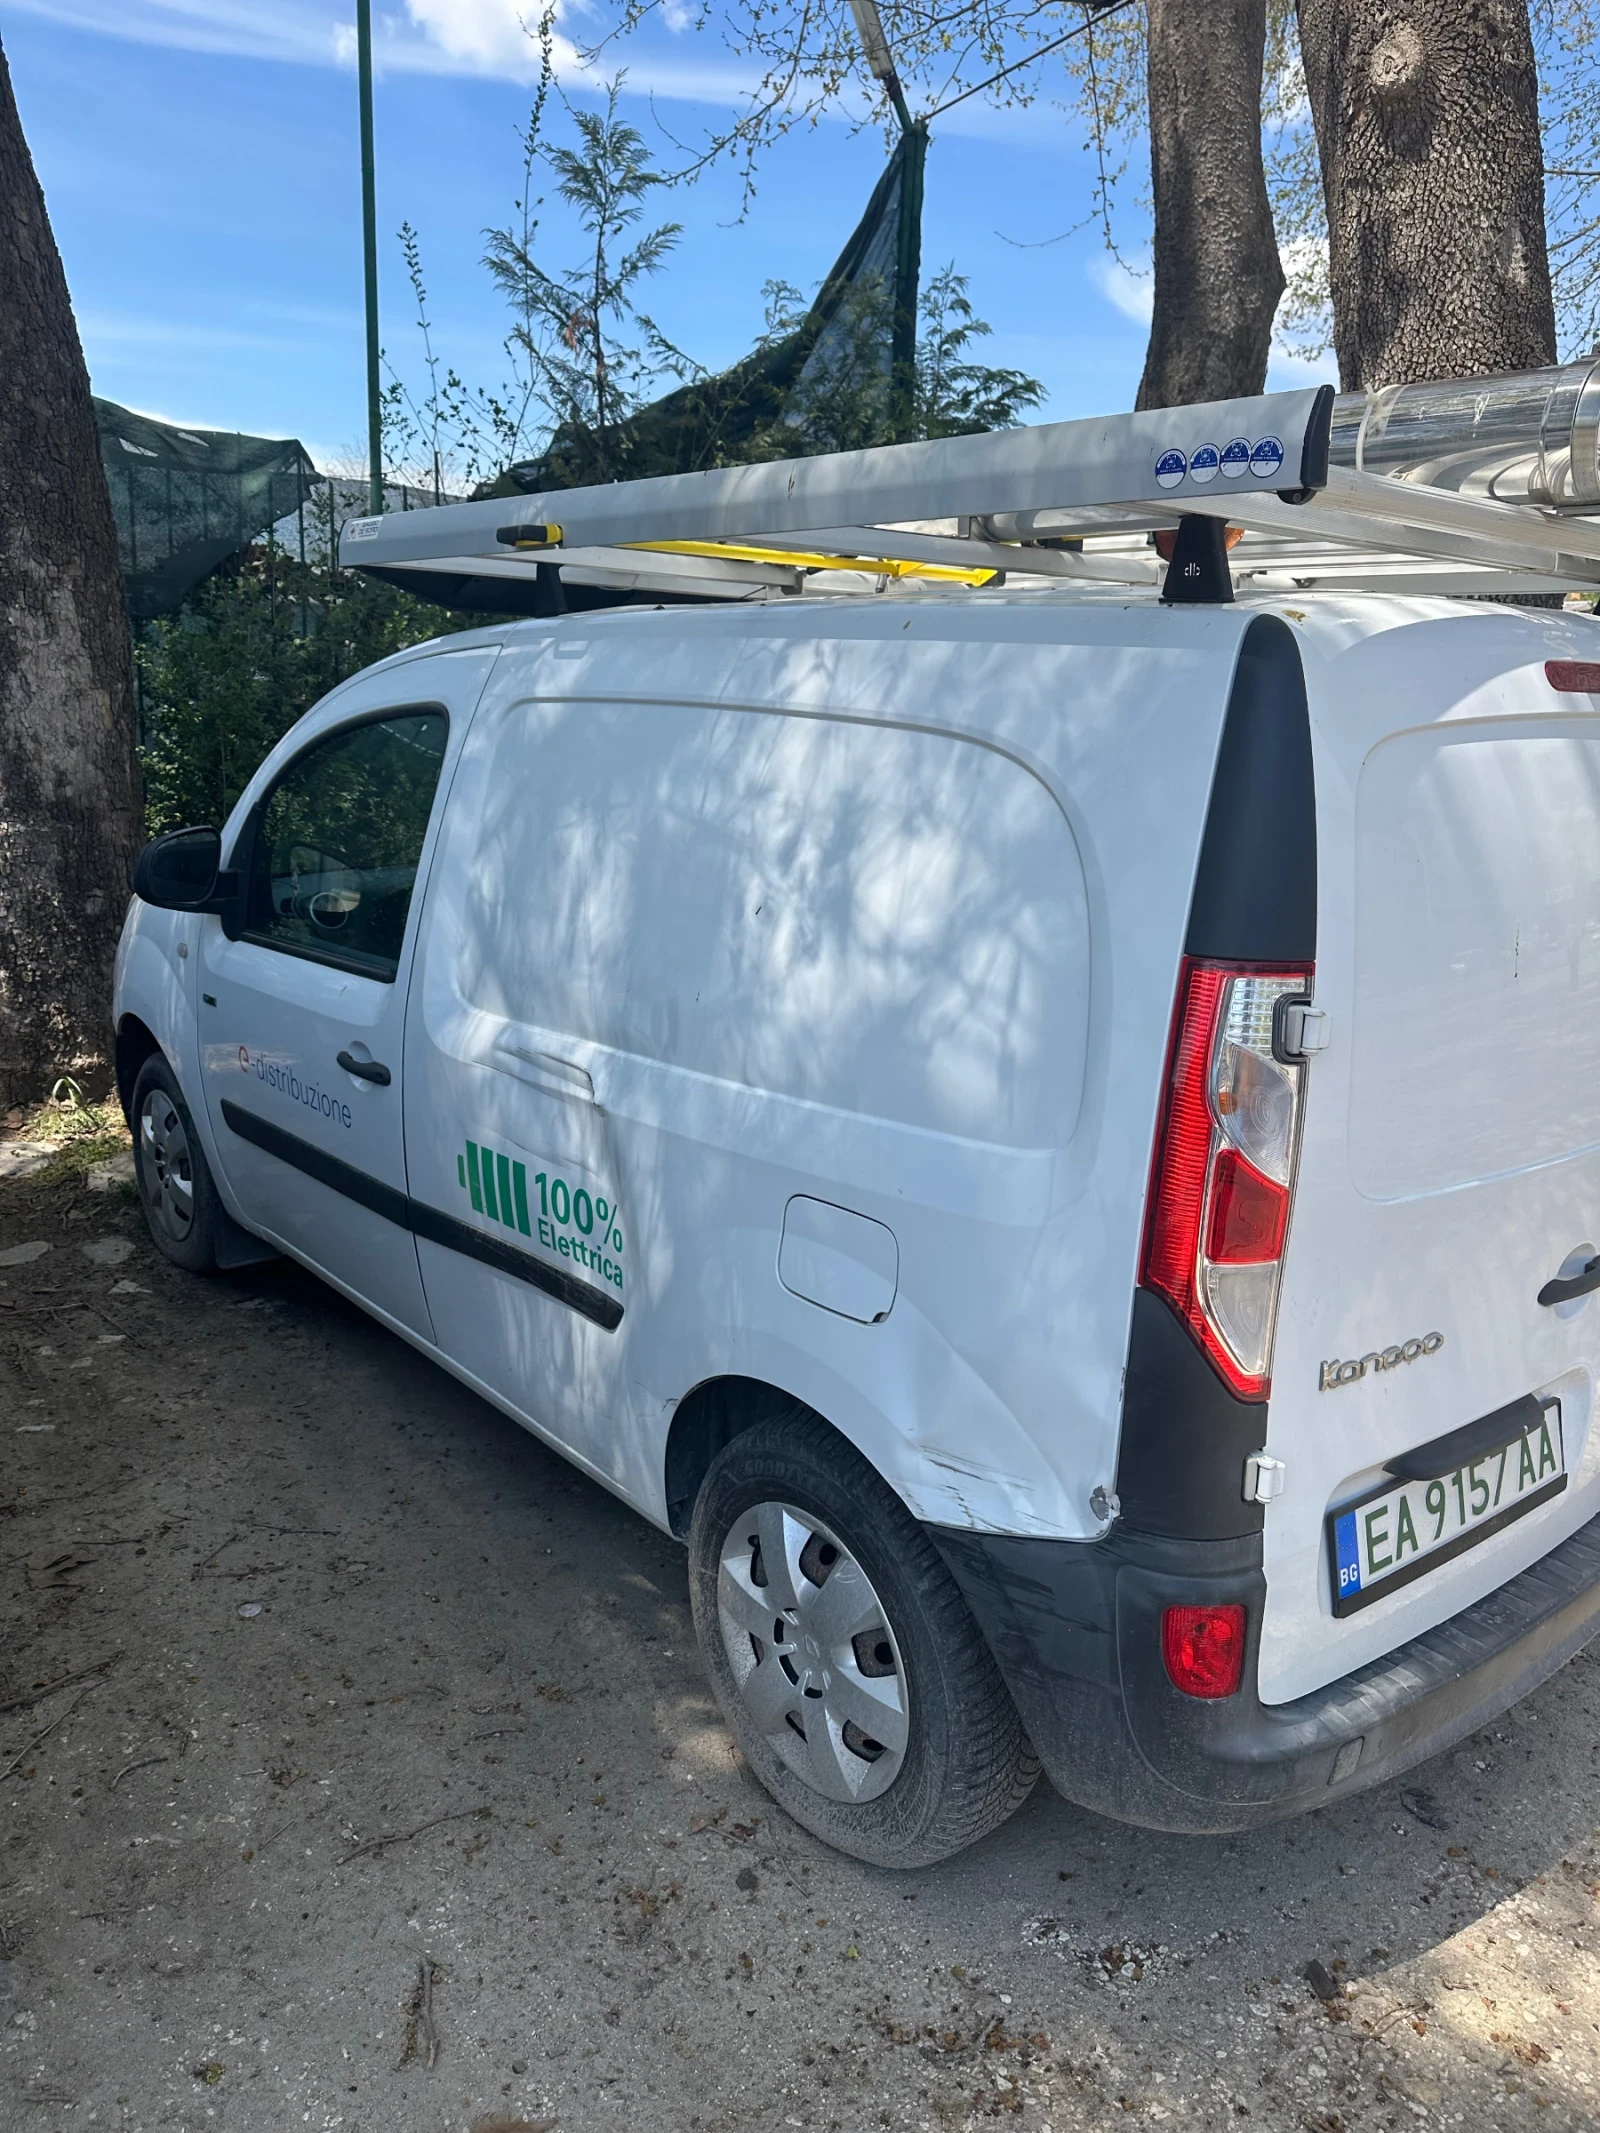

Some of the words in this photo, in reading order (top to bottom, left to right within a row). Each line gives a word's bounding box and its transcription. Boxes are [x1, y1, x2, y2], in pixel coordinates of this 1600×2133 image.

[238, 1045, 352, 1129] e-distribuzione
[535, 1172, 623, 1253] 100%
[539, 1218, 624, 1289] Elettrica
[1364, 1494, 1419, 1575] EA
[1425, 1449, 1508, 1541] 9157
[1518, 1420, 1556, 1492] AA
[1340, 1563, 1358, 1587] BG
